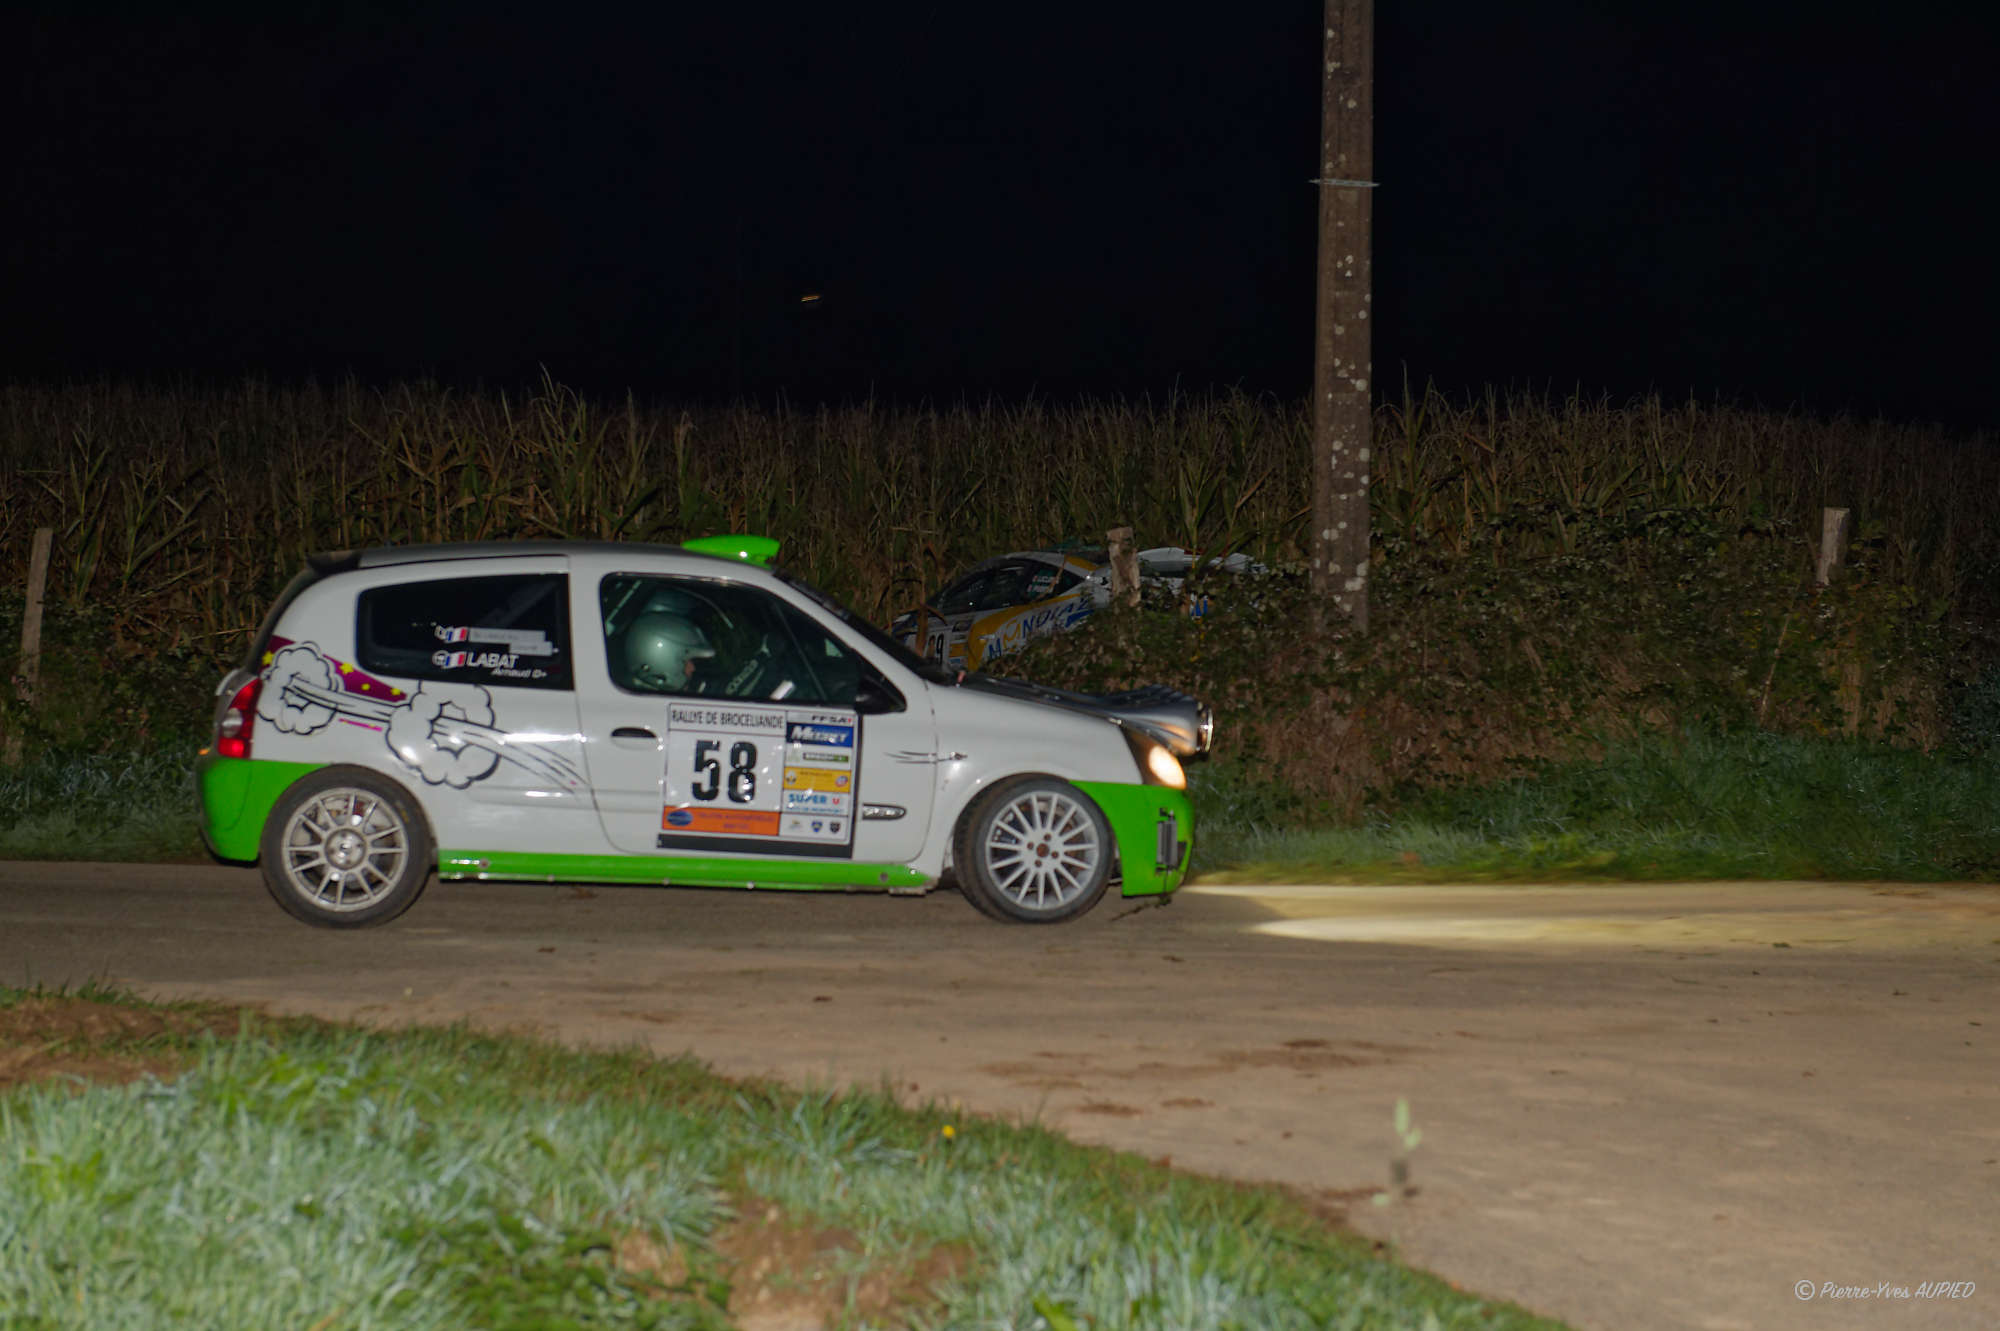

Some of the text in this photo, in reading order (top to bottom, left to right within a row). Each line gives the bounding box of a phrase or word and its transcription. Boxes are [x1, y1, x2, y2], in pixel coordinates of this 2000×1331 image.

[466, 651, 519, 668] LABAT
[491, 667, 531, 679] Arnaud
[672, 709, 784, 729] RALLYE DE BROCELIANDE
[812, 715, 847, 724] FFSA
[693, 739, 758, 803] 58
[787, 793, 840, 805] SUPER U
